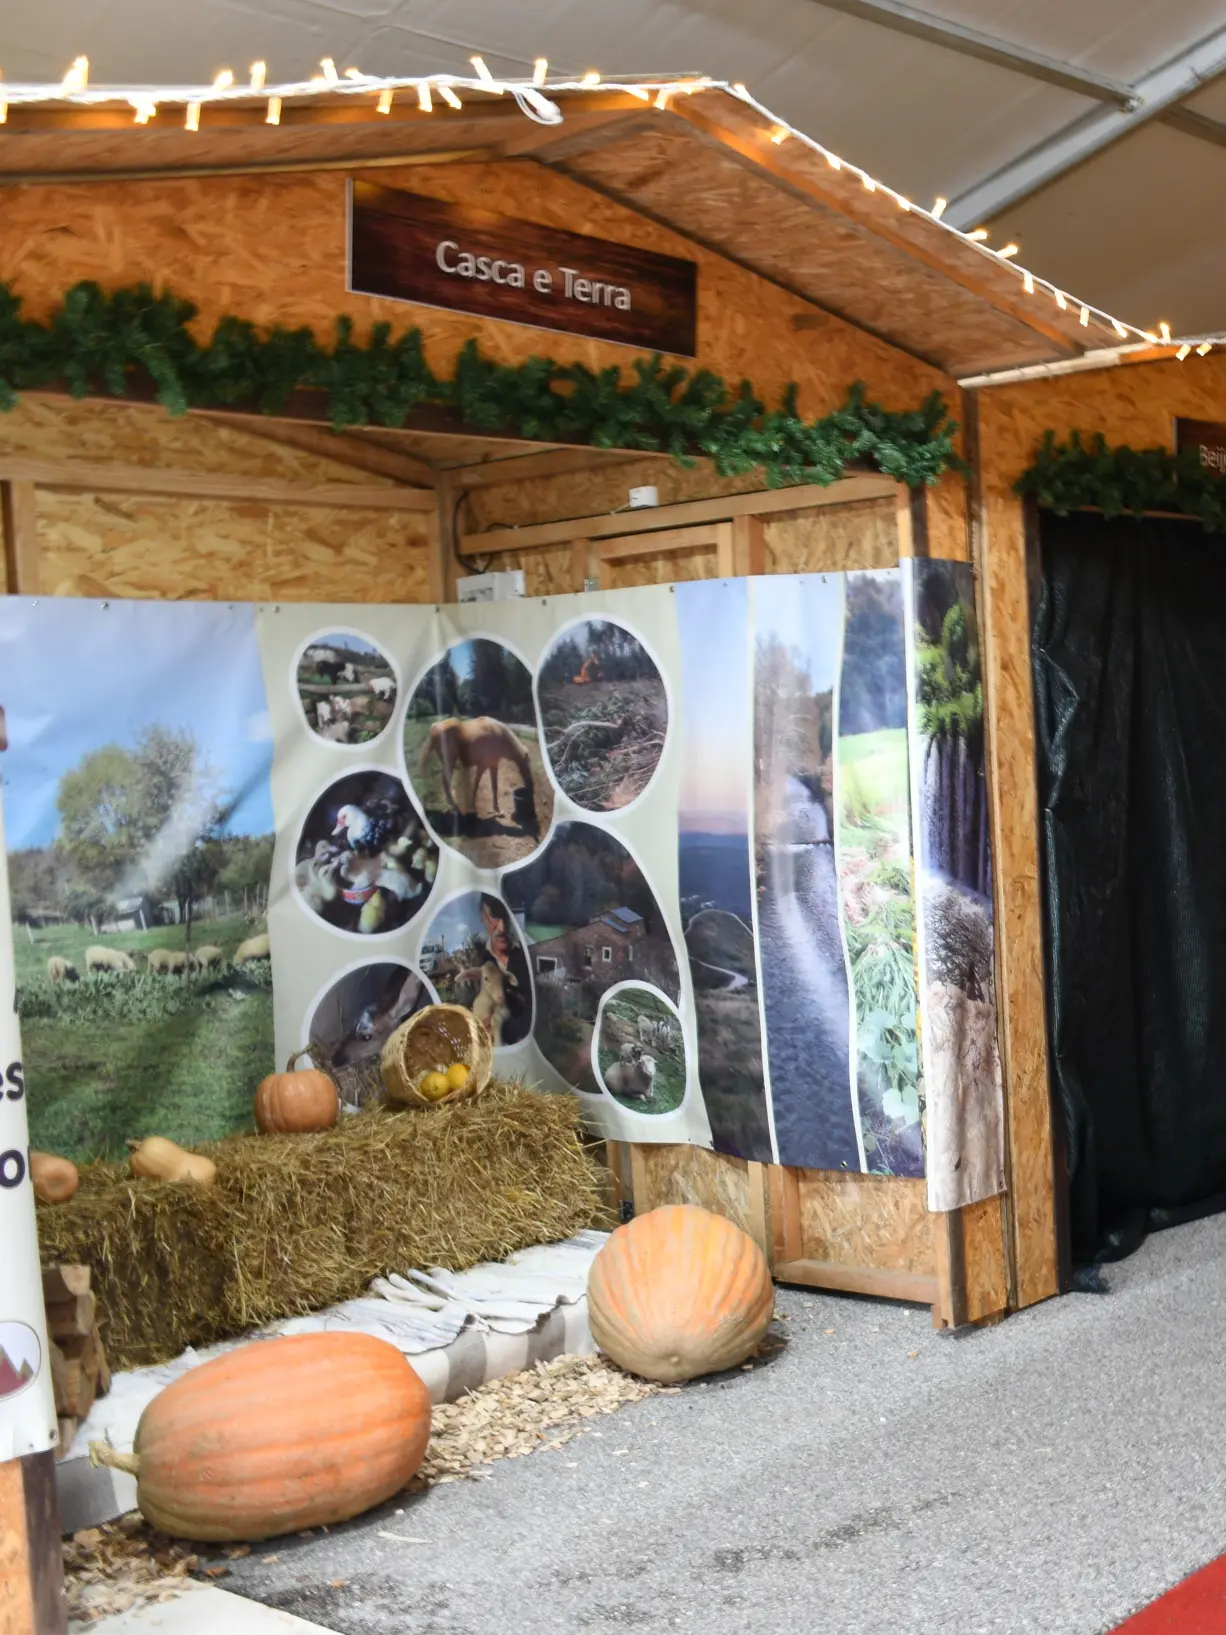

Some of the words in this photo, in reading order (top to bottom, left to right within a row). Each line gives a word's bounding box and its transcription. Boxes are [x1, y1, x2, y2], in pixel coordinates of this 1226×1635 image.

[436, 241, 525, 288] Casca
[533, 269, 552, 293] e
[558, 266, 631, 310] Terra
